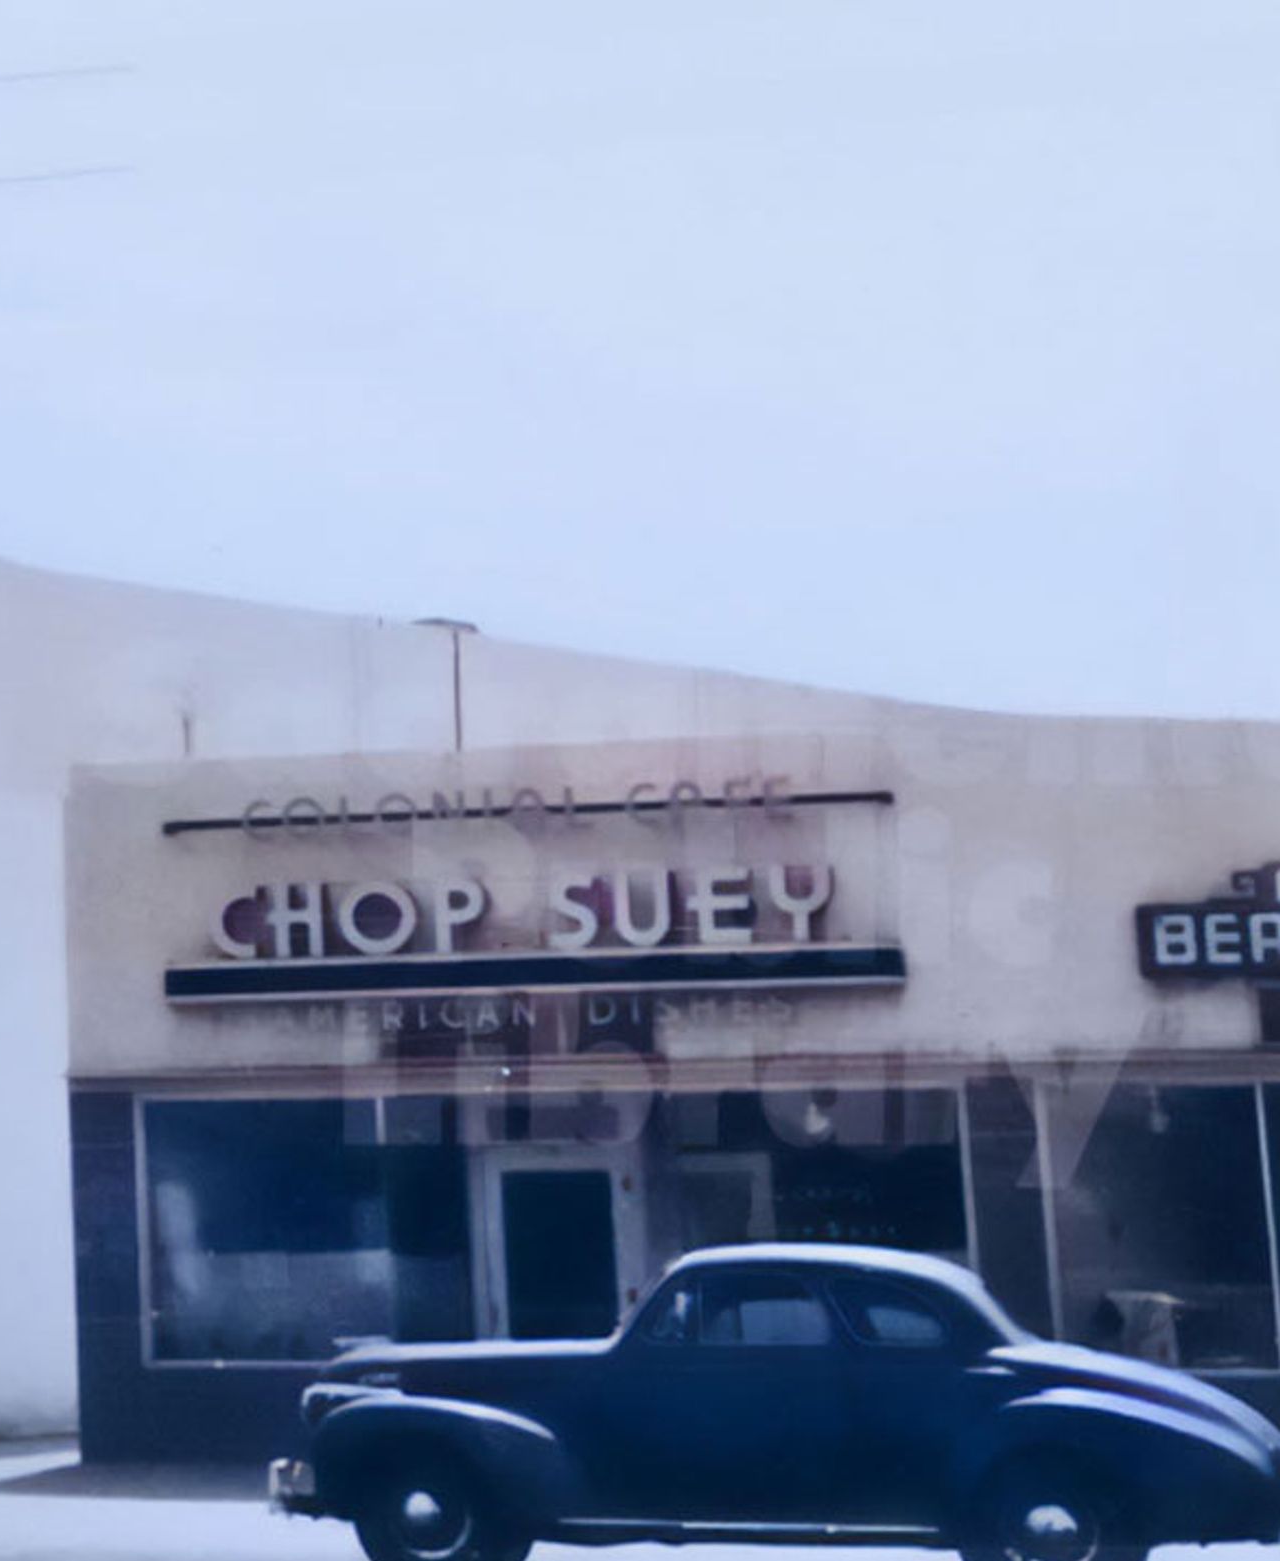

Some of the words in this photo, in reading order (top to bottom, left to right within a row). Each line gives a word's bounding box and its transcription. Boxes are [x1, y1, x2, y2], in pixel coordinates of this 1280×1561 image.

[242, 787, 584, 838] COLONIAL
[627, 776, 798, 824] CAFE
[210, 877, 490, 959] CHOP
[548, 864, 836, 950] SUEY
[277, 1000, 538, 1032] AMERICAN
[587, 993, 797, 1028] DISHES
